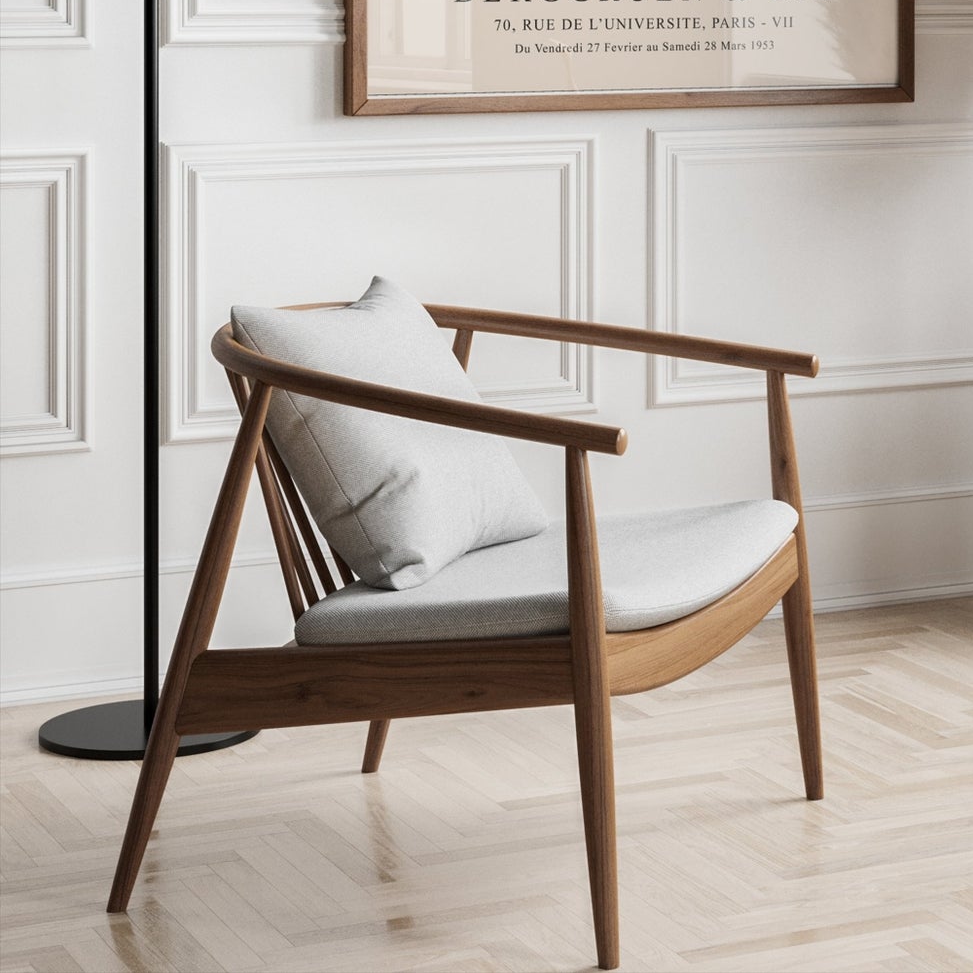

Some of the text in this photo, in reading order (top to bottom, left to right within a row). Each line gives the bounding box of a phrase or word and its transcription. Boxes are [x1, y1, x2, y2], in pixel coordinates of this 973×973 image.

[493, 18, 517, 33] 70,
[522, 18, 556, 31] RUE
[561, 18, 584, 31] DE
[711, 16, 756, 29] PARIS
[772, 15, 793, 28] VII
[514, 39, 775, 54] Du Vendredi 27 Fevrier au Samedi 28 Mars 1953
